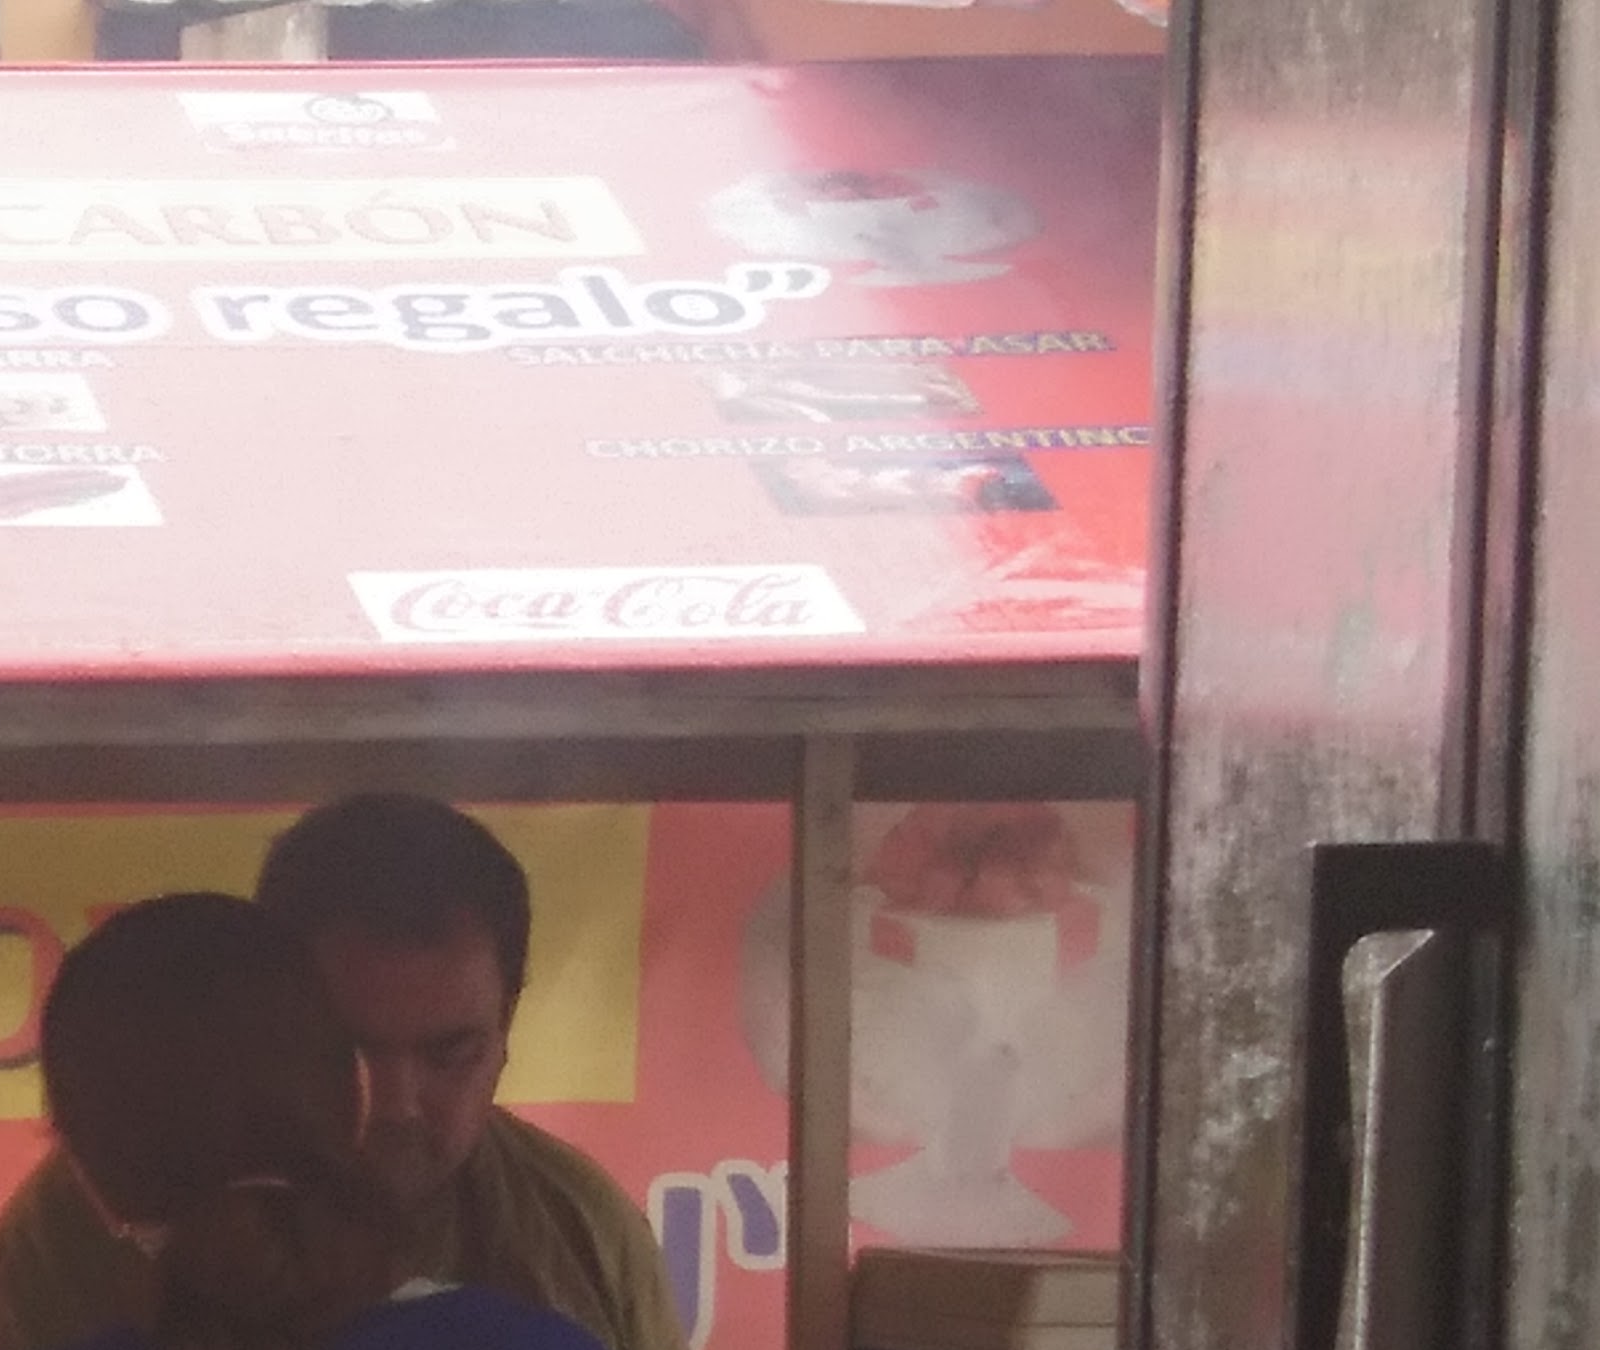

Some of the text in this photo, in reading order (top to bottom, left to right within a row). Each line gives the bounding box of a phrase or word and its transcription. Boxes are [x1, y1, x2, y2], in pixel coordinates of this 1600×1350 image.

[506, 331, 1109, 366] SALCHICHA PARA ASAR
[586, 435, 826, 459] CHORIZO
